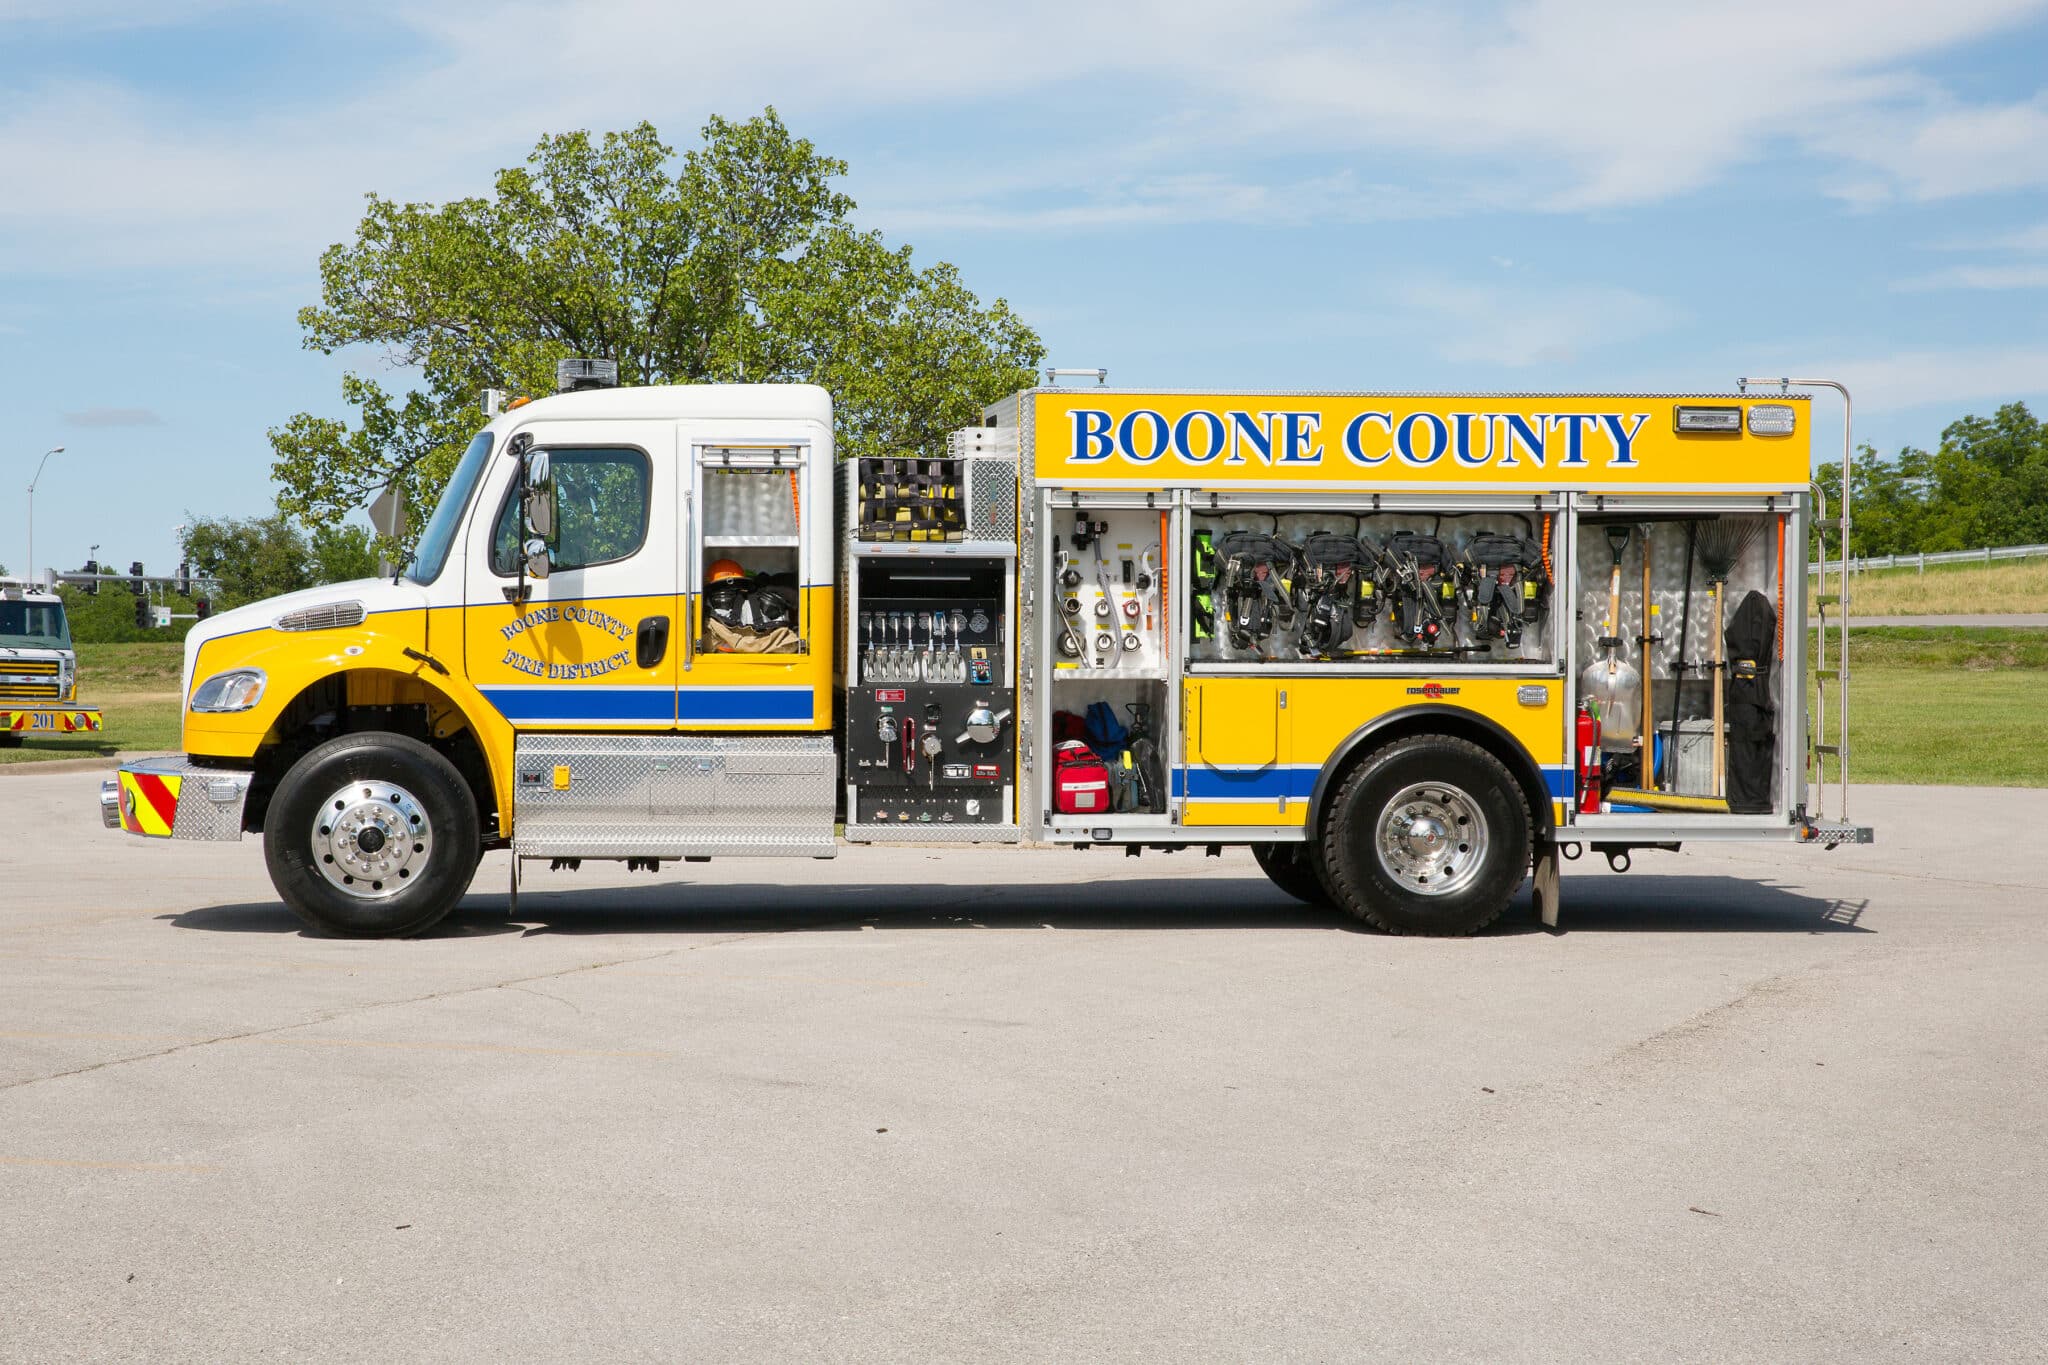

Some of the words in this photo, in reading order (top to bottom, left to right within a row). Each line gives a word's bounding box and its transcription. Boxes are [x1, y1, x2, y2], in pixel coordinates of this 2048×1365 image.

[1065, 409, 1324, 467] BOONE
[1342, 411, 1650, 468] COUNTY
[501, 606, 559, 641] BOONE
[563, 605, 633, 641] COUNTY
[502, 648, 545, 676] FIRE
[547, 649, 631, 680] DISTRICT
[1406, 685, 1460, 695] rosenbauer
[31, 713, 55, 729] 201
